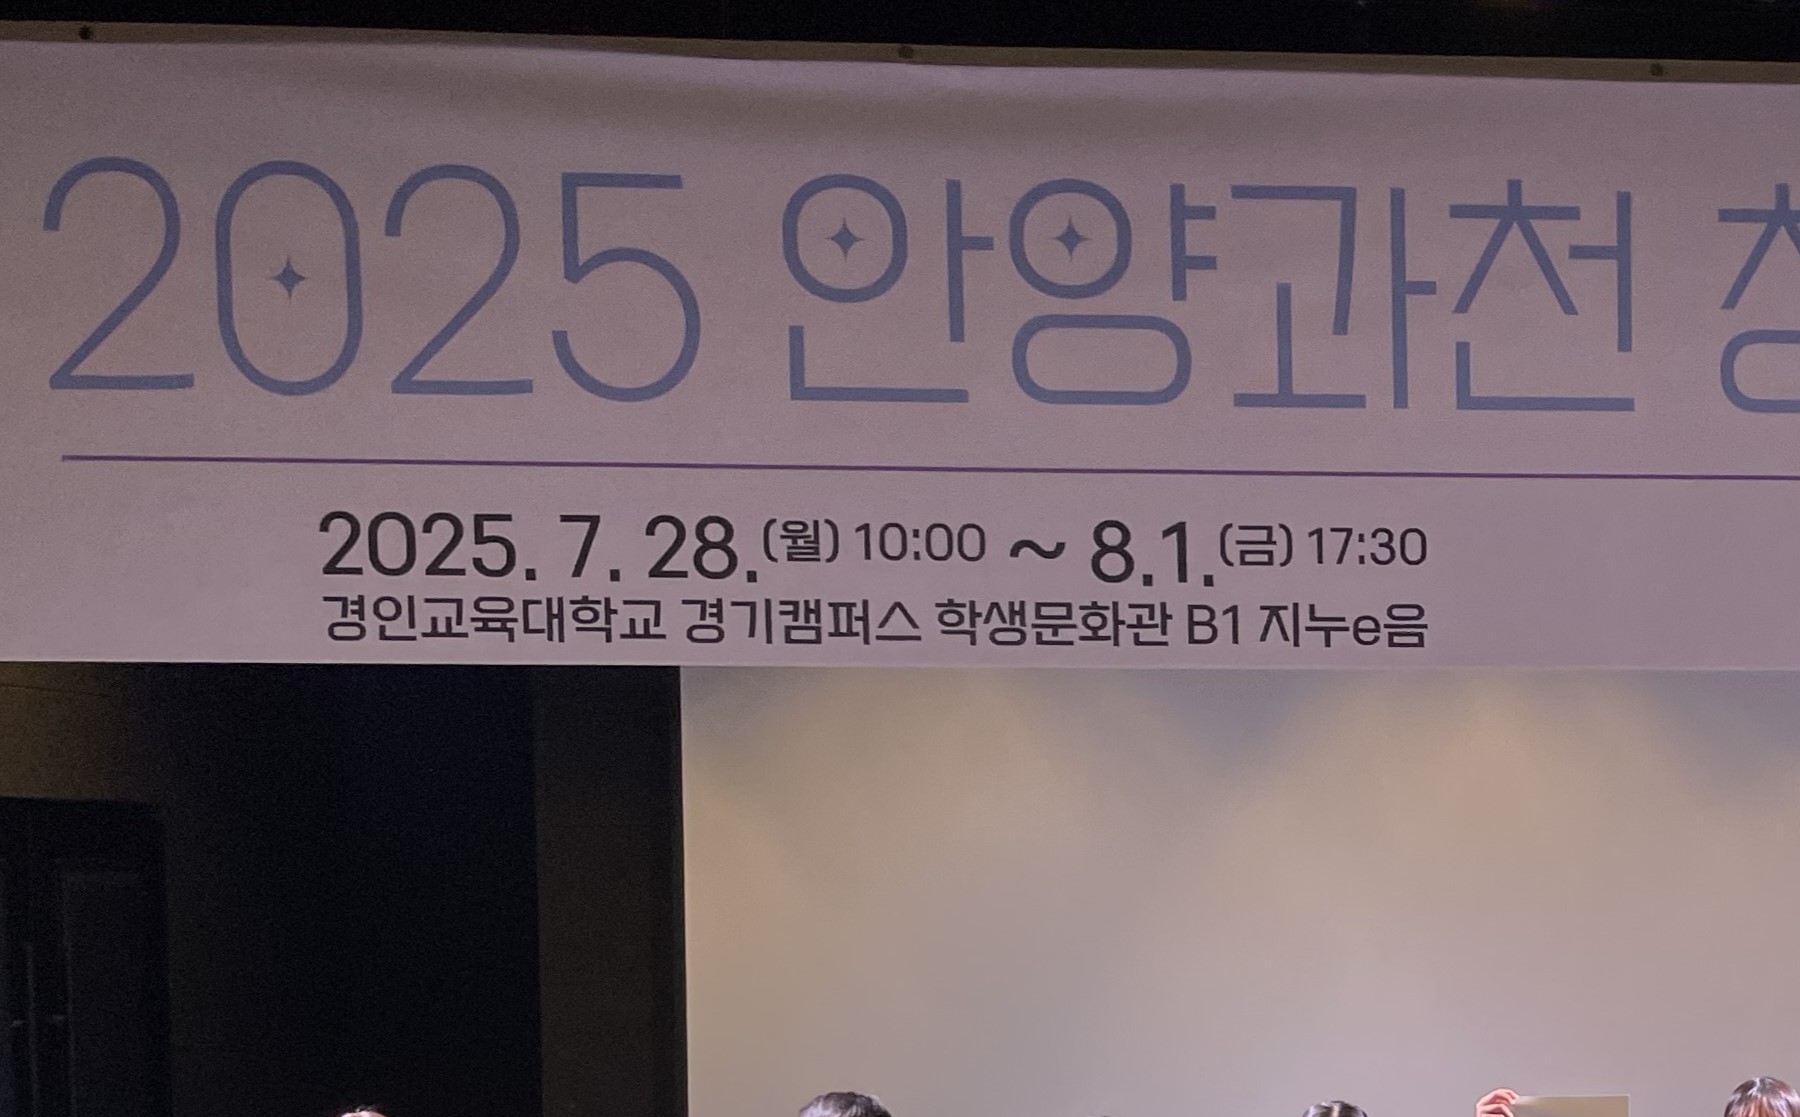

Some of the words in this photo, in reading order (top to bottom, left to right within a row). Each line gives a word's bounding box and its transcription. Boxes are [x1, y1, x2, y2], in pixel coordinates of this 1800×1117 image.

[43, 152, 700, 401] 2025
[782, 174, 1634, 411] 안양과천
[319, 511, 536, 580] 2025.
[560, 515, 620, 581] 7.
[855, 523, 985, 561] 10:00
[1309, 528, 1426, 565] 17:30
[323, 595, 667, 643] 경인교육대학교
[682, 598, 921, 645] 경기캠퍼스
[935, 599, 1172, 646] 학생문화관
[1188, 605, 1238, 644] B1
[1260, 603, 1428, 647] 지누e음
